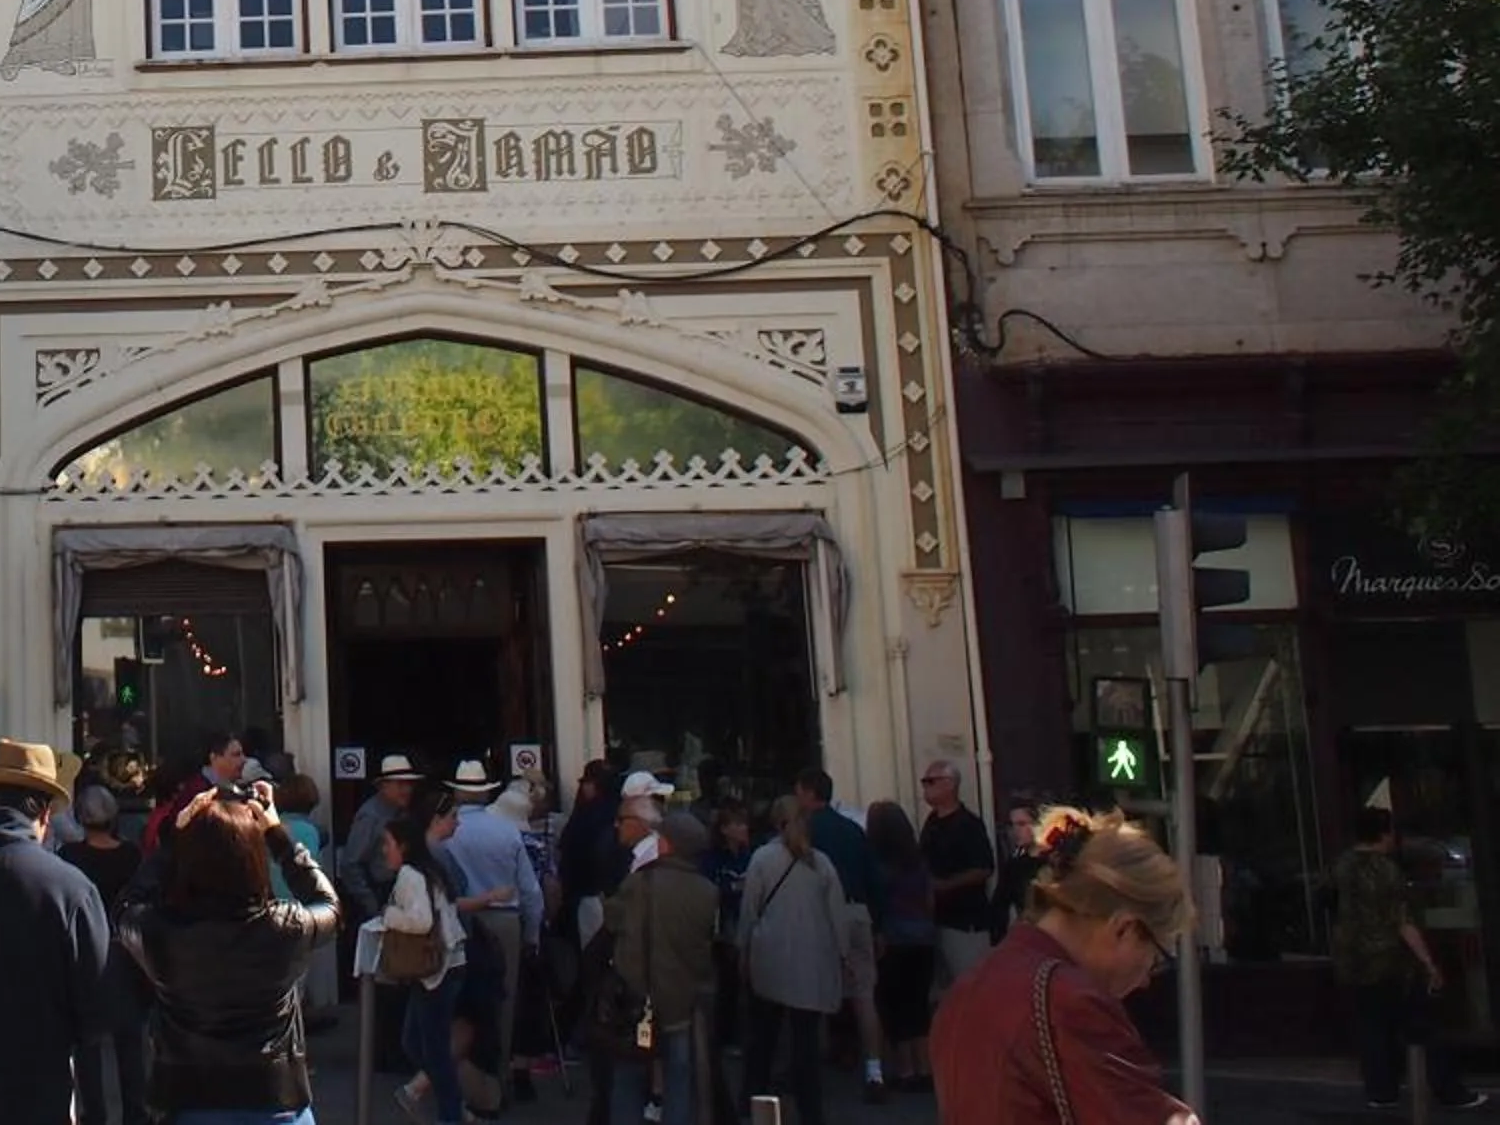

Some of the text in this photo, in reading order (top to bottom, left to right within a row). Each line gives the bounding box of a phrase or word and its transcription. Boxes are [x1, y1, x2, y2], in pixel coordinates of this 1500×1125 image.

[372, 150, 400, 181] &
[1331, 555, 1500, 599] Marques So
